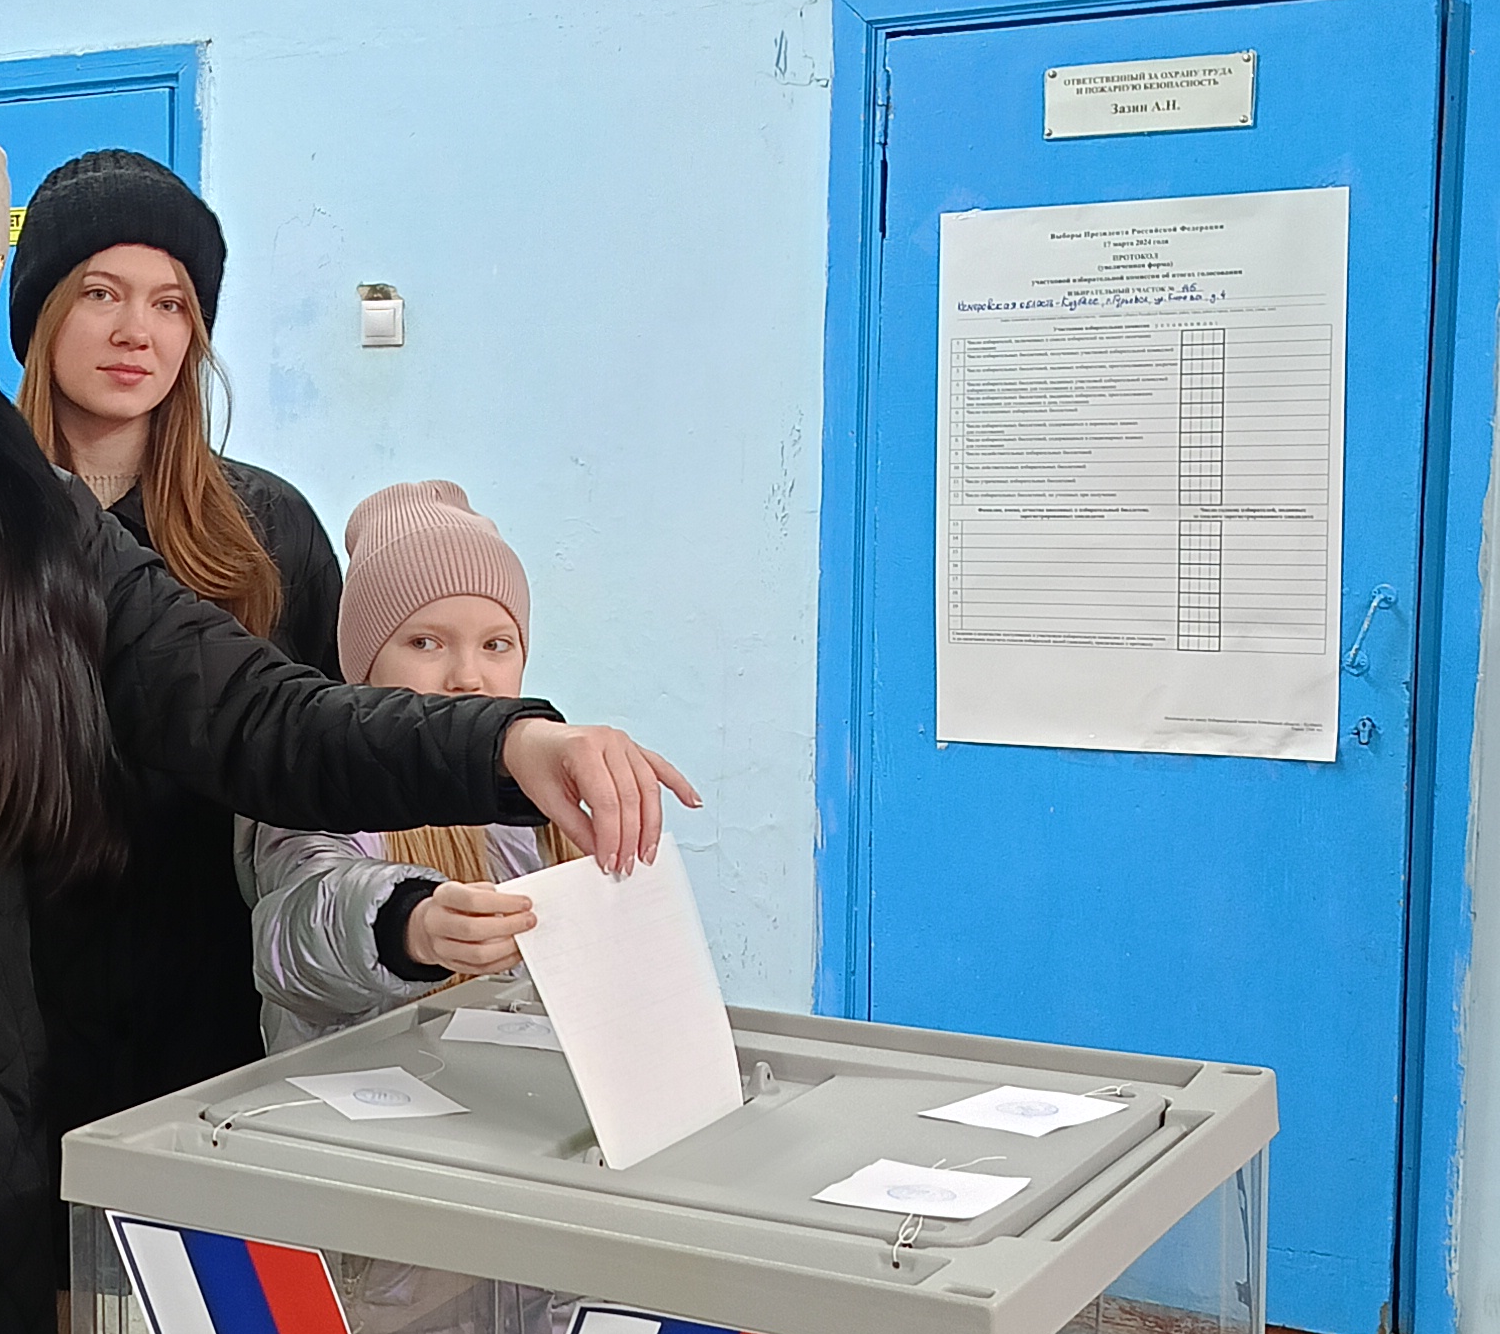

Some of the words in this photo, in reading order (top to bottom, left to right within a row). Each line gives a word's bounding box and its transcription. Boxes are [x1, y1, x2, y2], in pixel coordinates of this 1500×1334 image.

[1064, 73, 1145, 86] ОТВЕТСТВЕННЫЙ
[1149, 73, 1159, 81] ЗА
[1160, 69, 1199, 79] ОХРАНУ
[1202, 67, 1232, 77] ТРУДА
[1076, 87, 1083, 95] И
[1085, 83, 1141, 94] ПОЖАРНУЮ
[1143, 78, 1219, 91] БЕЗОПАСНОСТЬ
[1112, 252, 1159, 261] ПРОТОКОЛ
